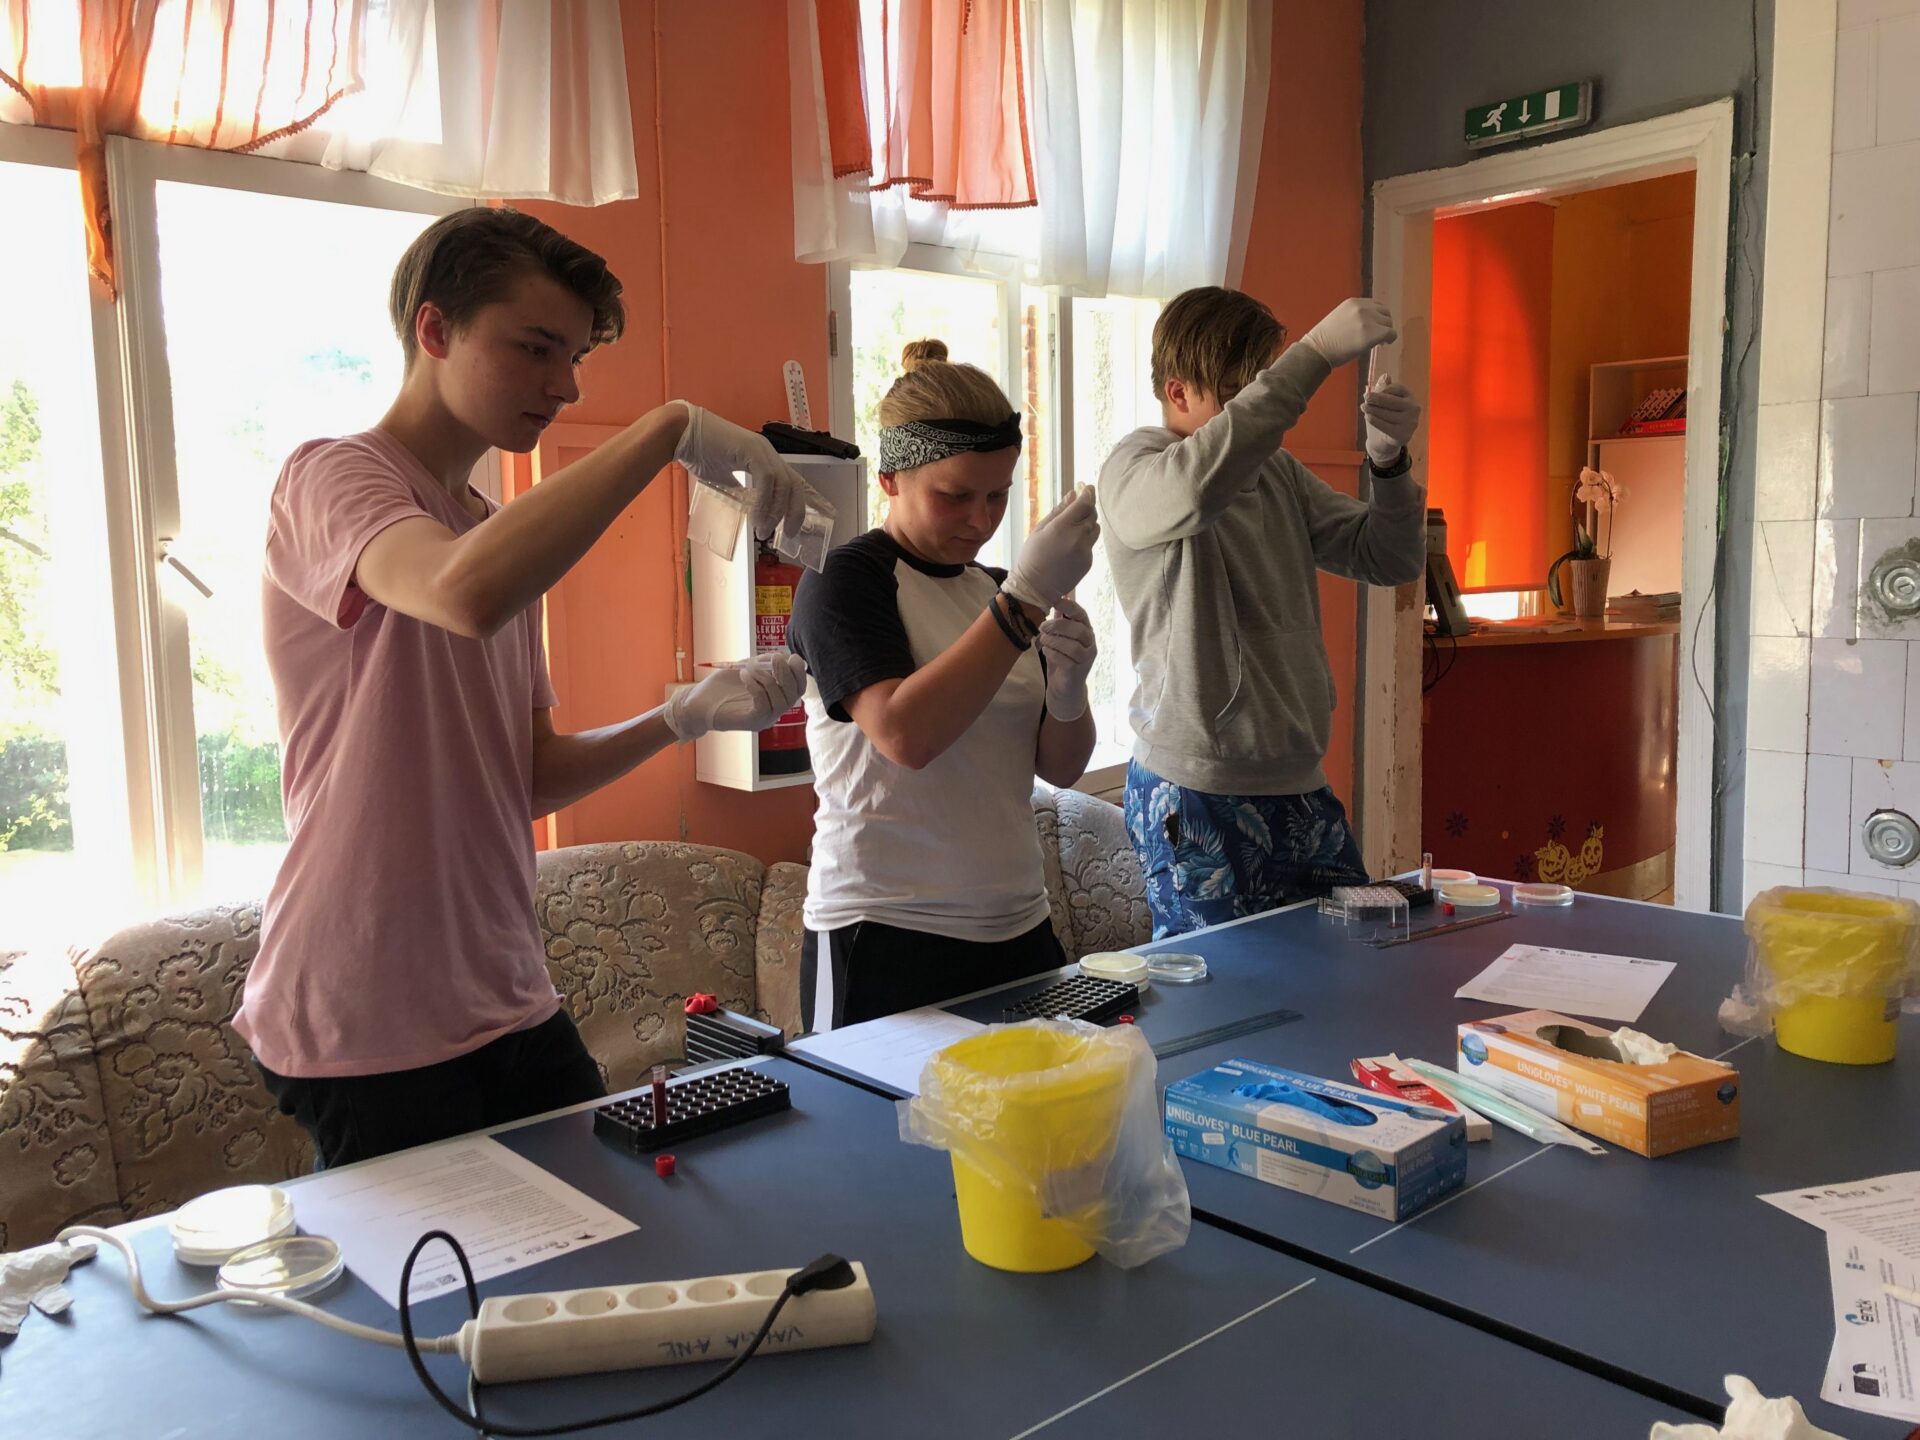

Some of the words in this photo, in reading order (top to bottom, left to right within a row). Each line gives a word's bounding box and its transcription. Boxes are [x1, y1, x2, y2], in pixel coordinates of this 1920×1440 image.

[1291, 1078, 1321, 1093] BLUE
[1322, 1085, 1358, 1101] PEARL
[1575, 1082, 1607, 1104] WHITE
[1608, 1093, 1643, 1118] PEARL
[1231, 1124, 1261, 1143] BLUE
[1263, 1132, 1301, 1155] PEARL
